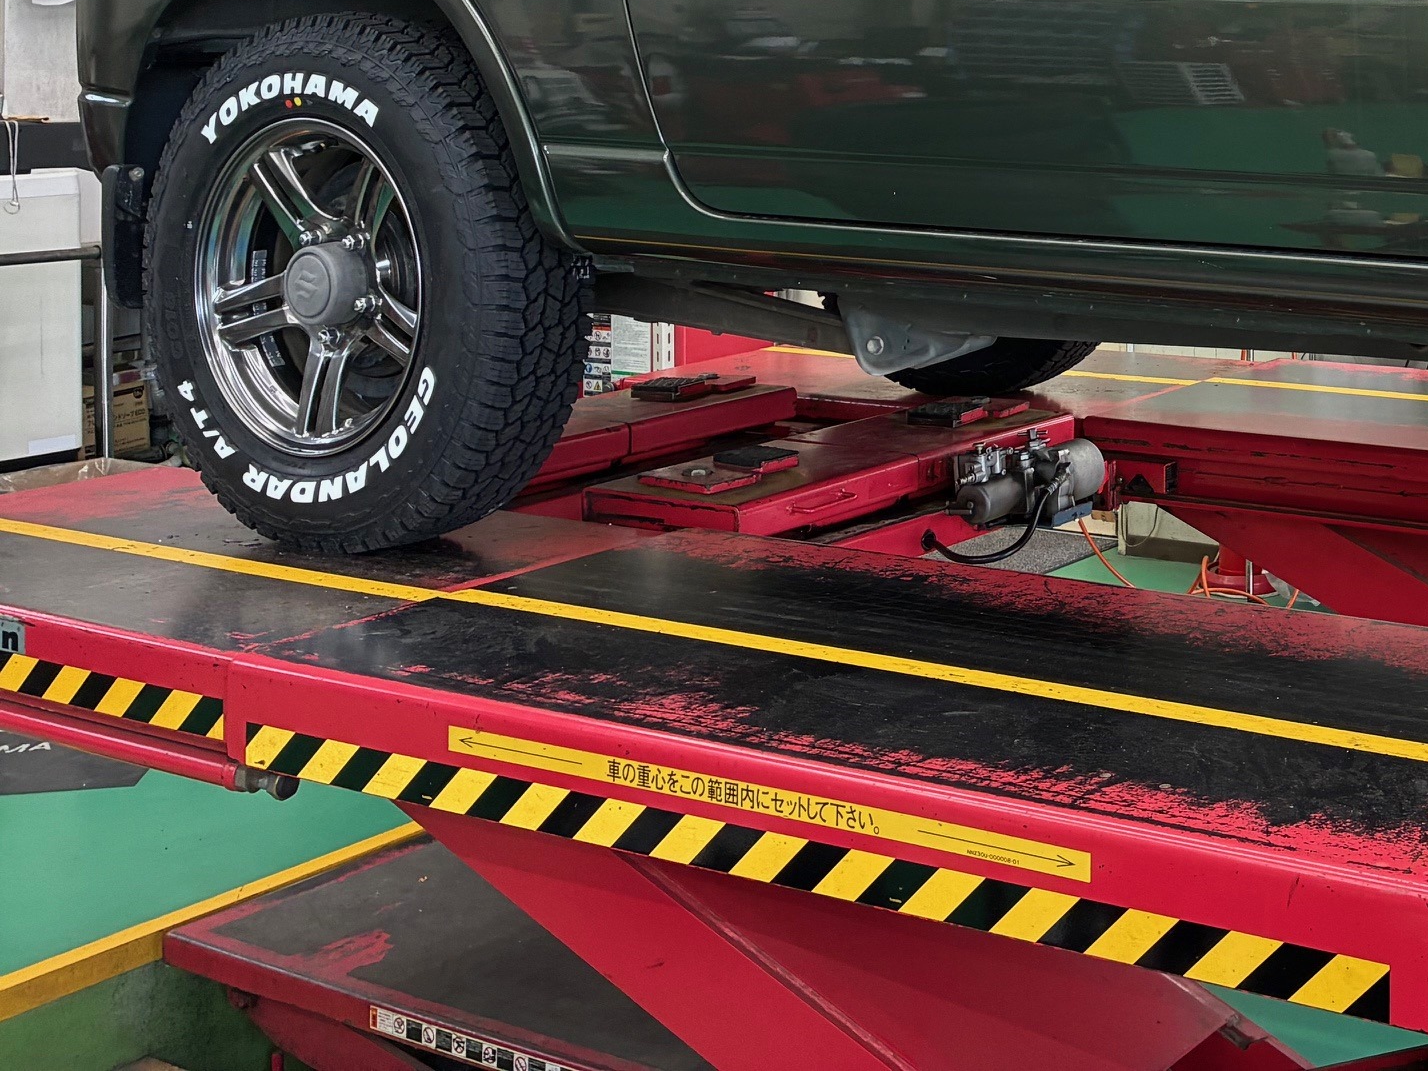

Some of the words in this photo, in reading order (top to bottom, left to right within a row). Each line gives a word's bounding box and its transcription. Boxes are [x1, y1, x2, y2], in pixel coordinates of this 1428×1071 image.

[201, 73, 378, 143] YOKOHAMA
[243, 367, 436, 503] GEOLANDAR
[606, 758, 881, 836] 車の重心をこの範囲内にセットして下さい。
